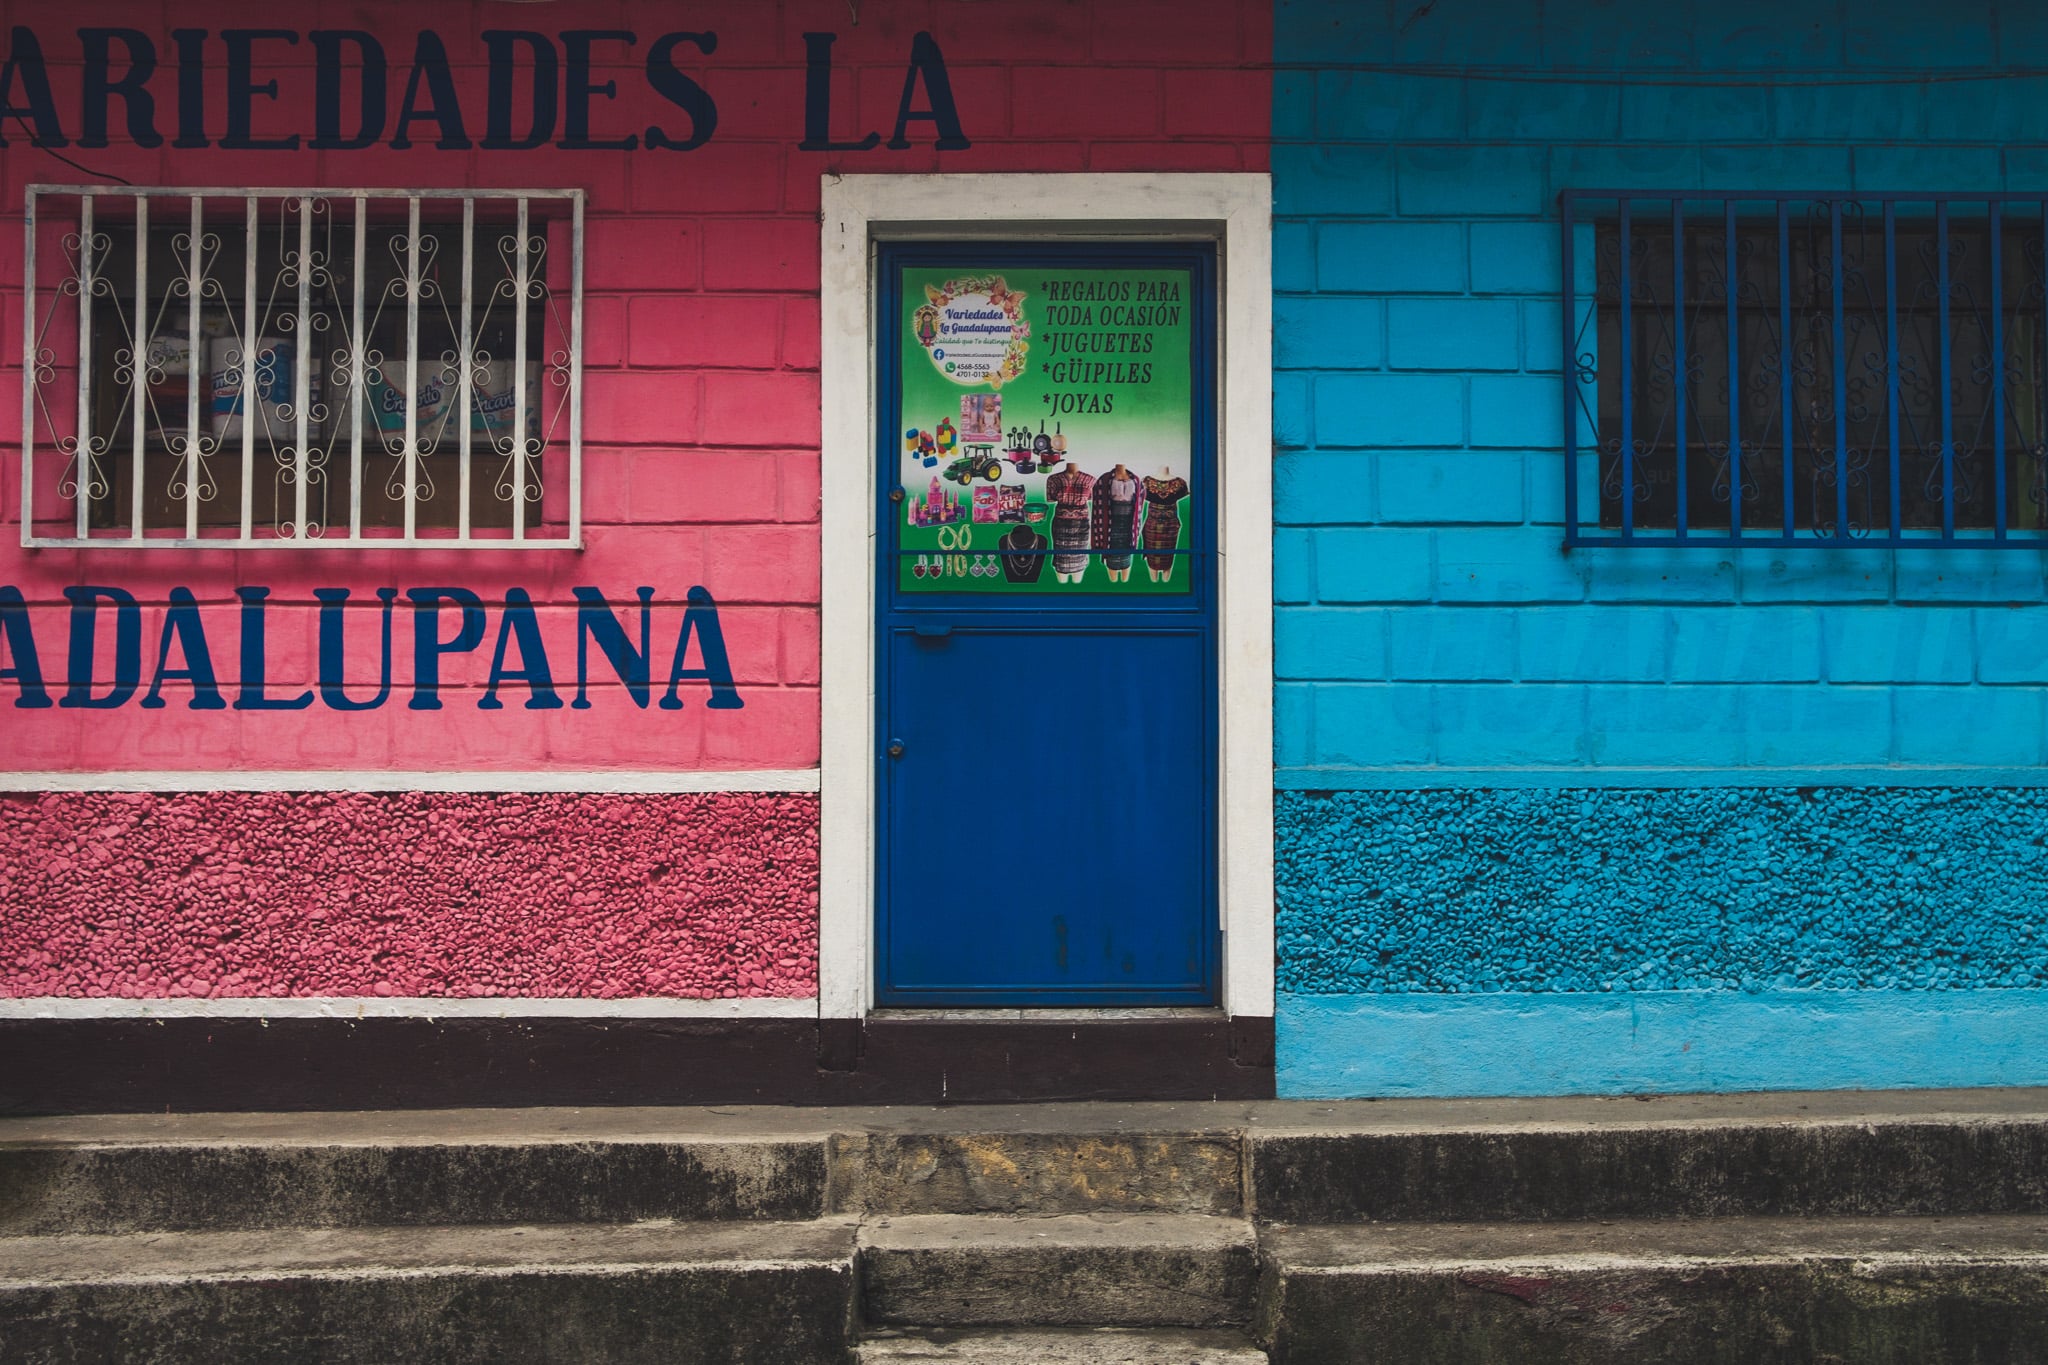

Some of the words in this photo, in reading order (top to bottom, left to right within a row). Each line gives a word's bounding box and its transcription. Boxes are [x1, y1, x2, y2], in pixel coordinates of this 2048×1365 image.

[0, 26, 718, 152] ARIEDADES
[799, 30, 972, 152] LA
[1136, 281, 1181, 302] PARA
[945, 309, 1003, 320] Variedades
[1046, 305, 1093, 326] TODA
[1100, 303, 1181, 327] OCASIÓN
[940, 323, 950, 334] La
[952, 323, 1011, 335] Guadalupana
[973, 496, 995, 505] Fab
[0, 585, 745, 711] ADALUPANA
